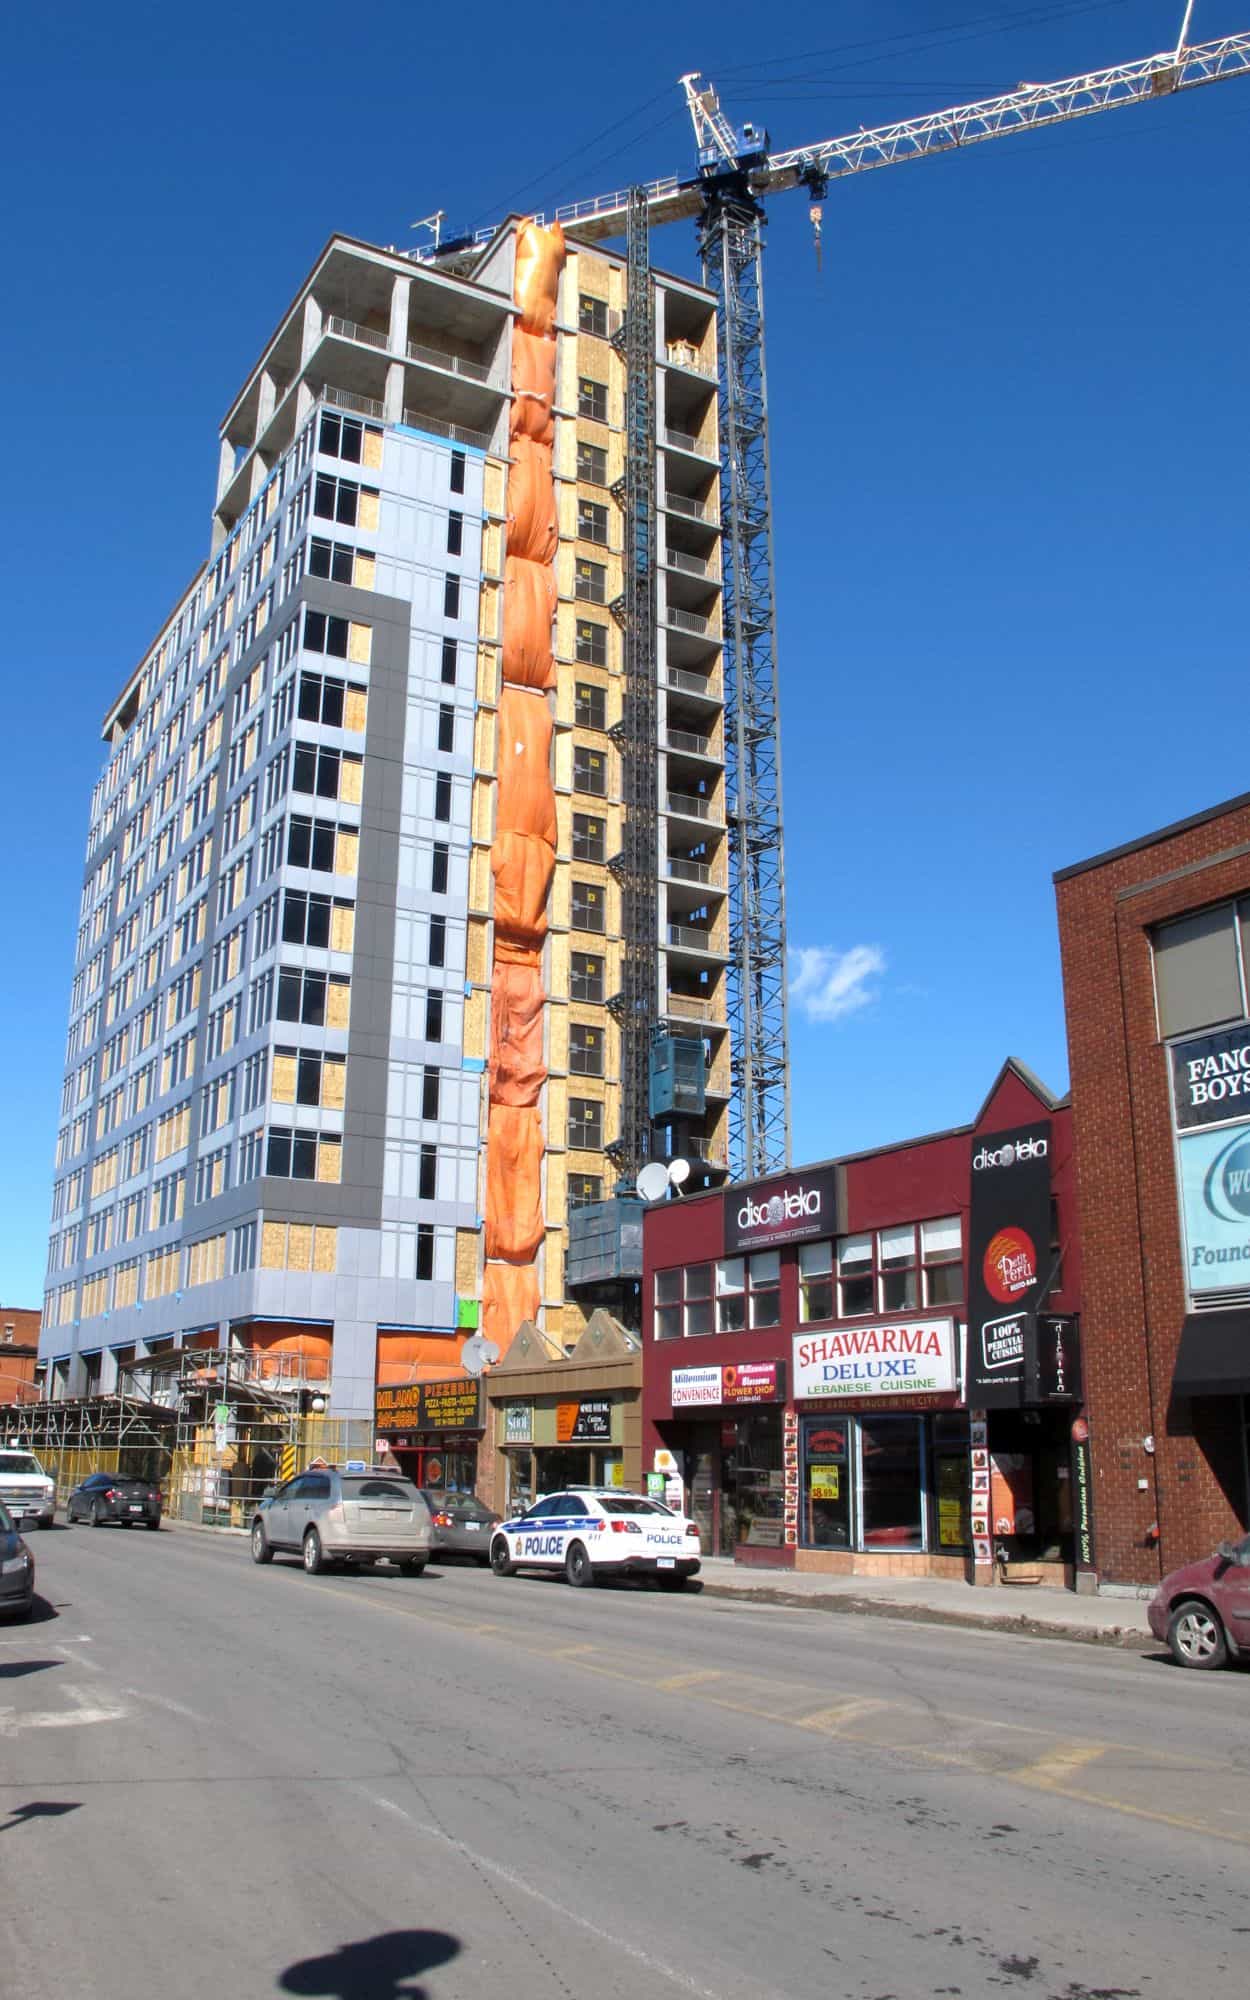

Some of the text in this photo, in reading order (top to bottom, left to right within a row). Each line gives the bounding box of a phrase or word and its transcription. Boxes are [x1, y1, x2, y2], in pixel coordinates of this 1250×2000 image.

[993, 1322, 1021, 1340] 100%
[799, 1329, 942, 1368] SHAWARMA
[674, 1371, 718, 1384] Millennium
[823, 1358, 917, 1381] DELUXE
[424, 1381, 477, 1397] PIZZERIA
[672, 1387, 720, 1401] CONVENIENCE
[723, 1384, 775, 1397] FLOWER SHOP
[807, 1378, 937, 1395] LEBANESE CUISINE
[525, 1536, 564, 1556] POLICE
[647, 1534, 683, 1545] POLICE
[1081, 1534, 1090, 1564] 100%
